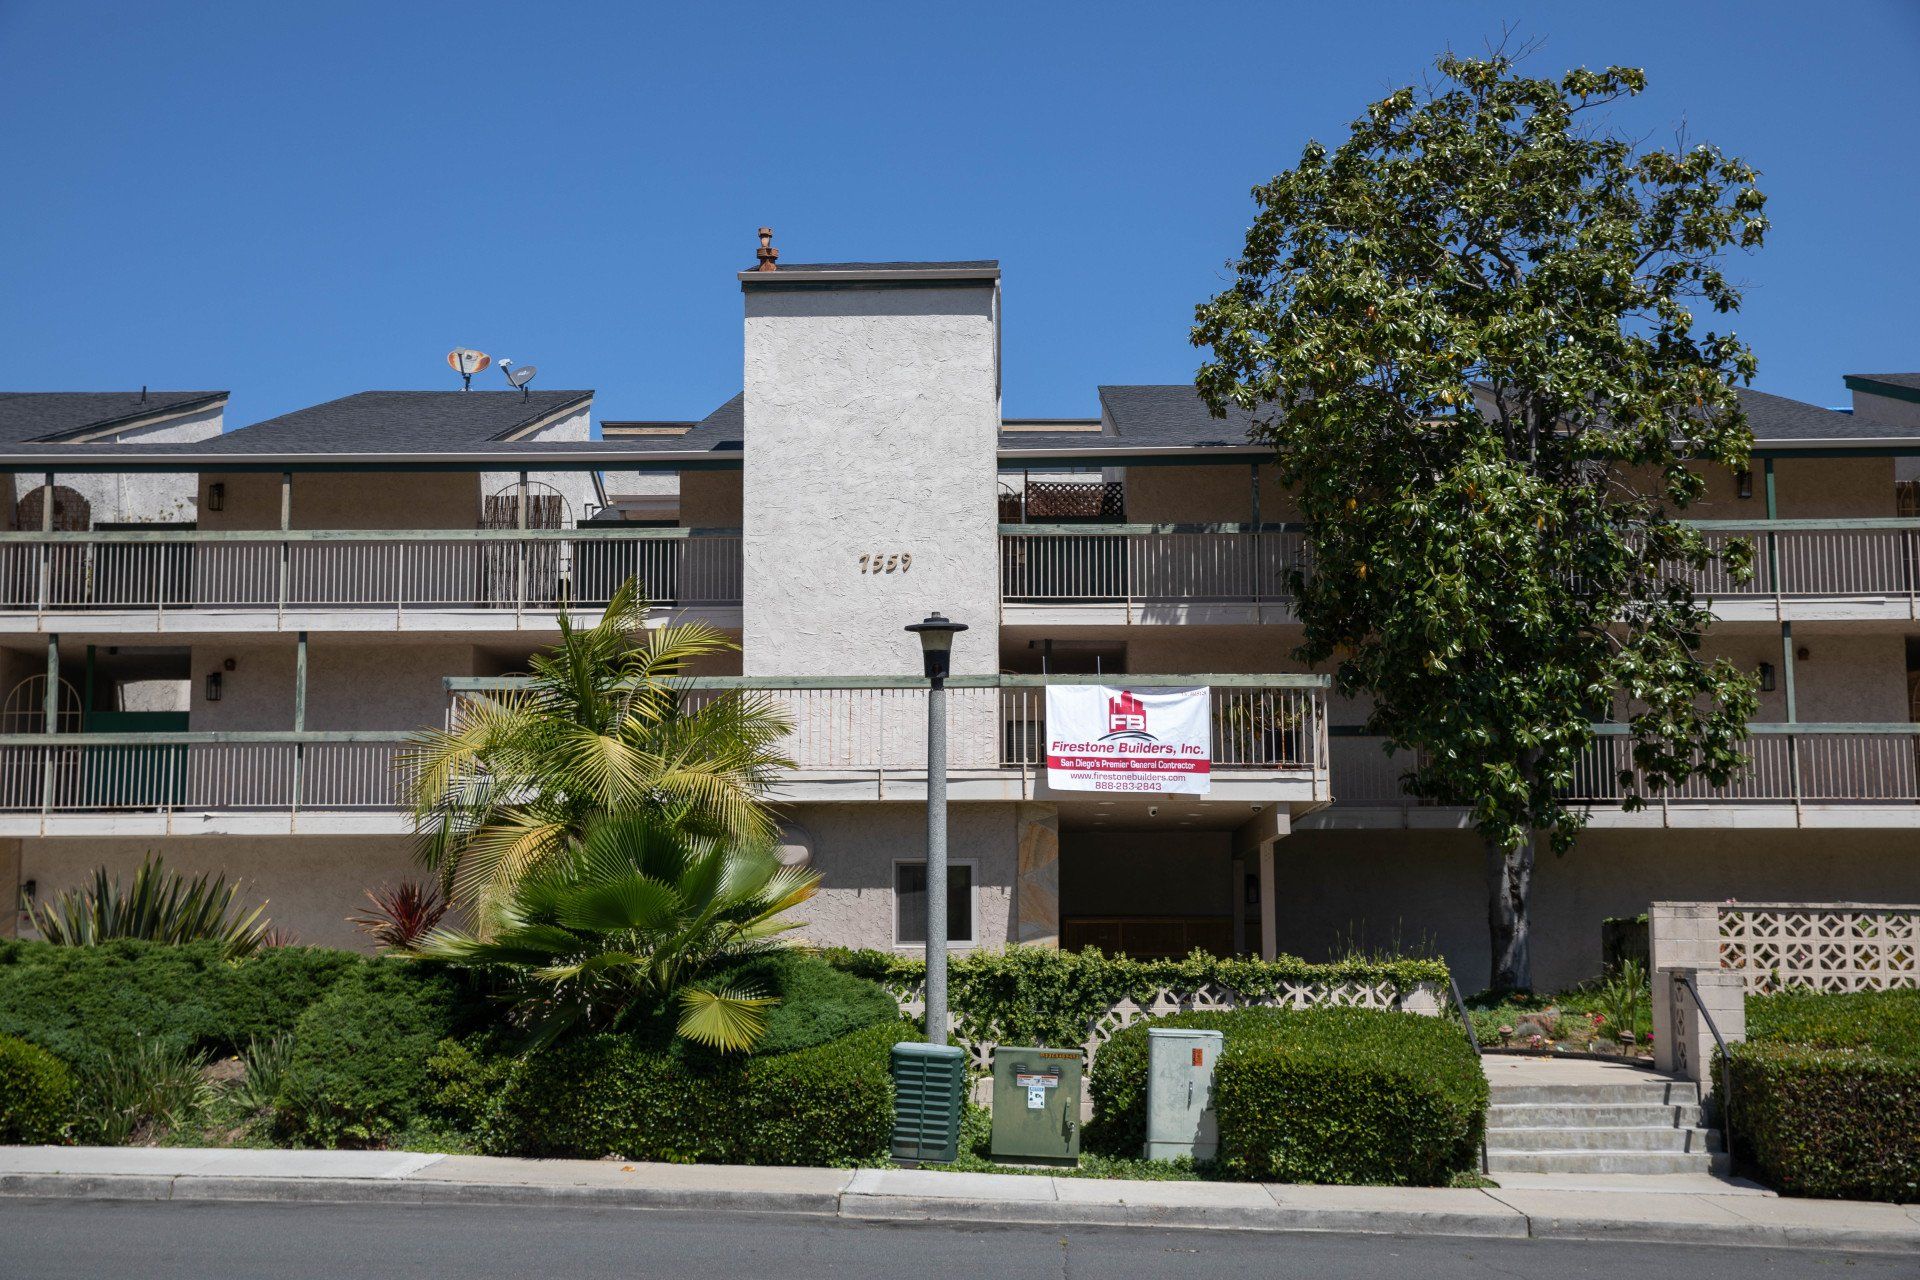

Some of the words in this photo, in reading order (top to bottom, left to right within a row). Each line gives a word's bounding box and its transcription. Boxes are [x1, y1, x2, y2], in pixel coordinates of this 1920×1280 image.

[859, 553, 912, 575] 1559
[1110, 714, 1146, 730] FB
[1052, 741, 1115, 753] Firestone
[1118, 742, 1176, 756] Builders,
[1181, 743, 1204, 755] Inc.
[1060, 758, 1074, 767] San
[1075, 758, 1101, 769] Diego's
[1101, 760, 1130, 768] Premier
[1130, 760, 1157, 769] General
[1158, 761, 1196, 770] Contractor
[1070, 772, 1186, 782] www.firestonebuilders.com
[1095, 781, 1162, 791] 888-283-2843
